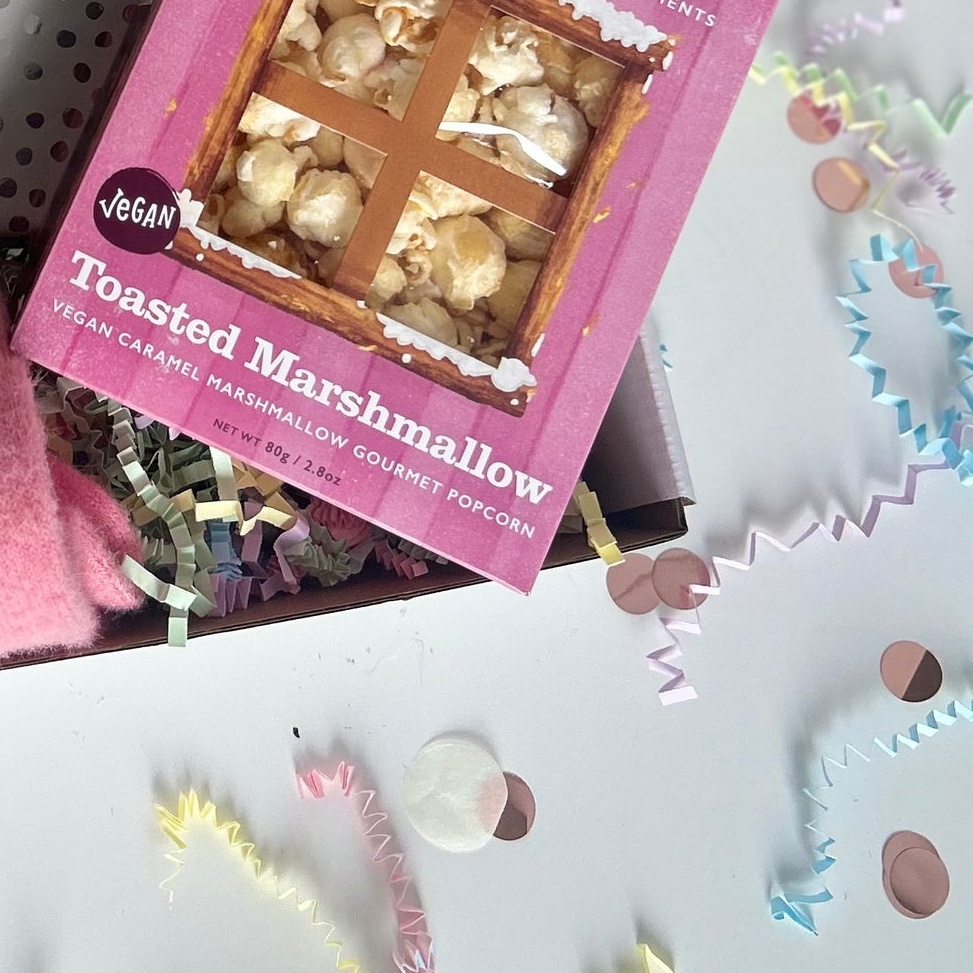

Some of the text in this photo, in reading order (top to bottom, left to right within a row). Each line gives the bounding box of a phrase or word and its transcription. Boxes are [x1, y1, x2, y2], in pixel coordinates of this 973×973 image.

[50, 298, 536, 539] VEGAN CARAMEL MARSHMALLOW GOURMET POPCORN
[68, 249, 553, 506] Toasted Marshmallow
[212, 418, 342, 486] NET WT 80g / 2.8oz
